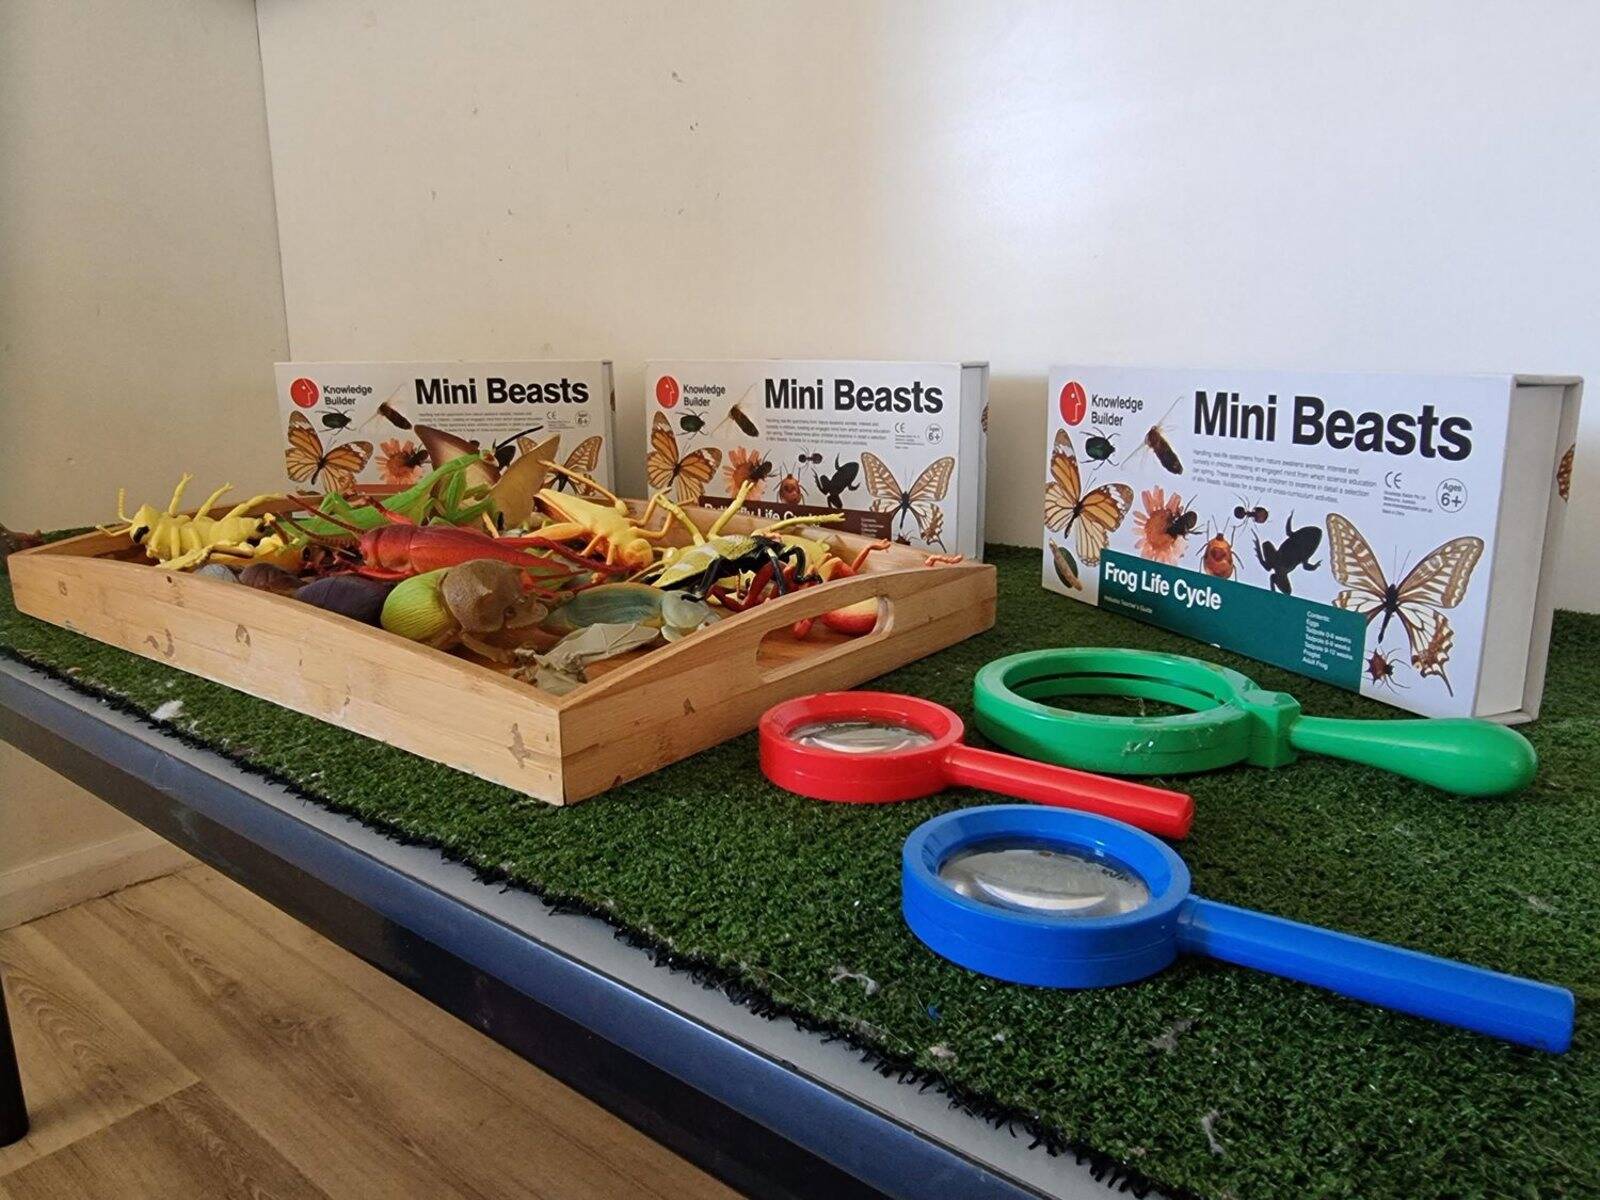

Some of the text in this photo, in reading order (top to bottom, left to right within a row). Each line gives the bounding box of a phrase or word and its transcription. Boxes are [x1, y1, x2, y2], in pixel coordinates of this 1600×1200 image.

[323, 385, 372, 396] Knowledge
[415, 378, 590, 404] Mini Beasts
[683, 384, 726, 396] Knowledge
[764, 379, 943, 414] Mini Beasts
[324, 397, 356, 405] Builder
[684, 396, 710, 407] Builder
[1091, 394, 1143, 413] Knowledge
[1091, 411, 1124, 426] Builder
[1194, 391, 1473, 461] Mini Beasts
[928, 432, 941, 441] 6+
[1443, 482, 1462, 492] Ages
[1441, 492, 1462, 507] 6+
[1105, 562, 1221, 610] Frog Life Cycle
